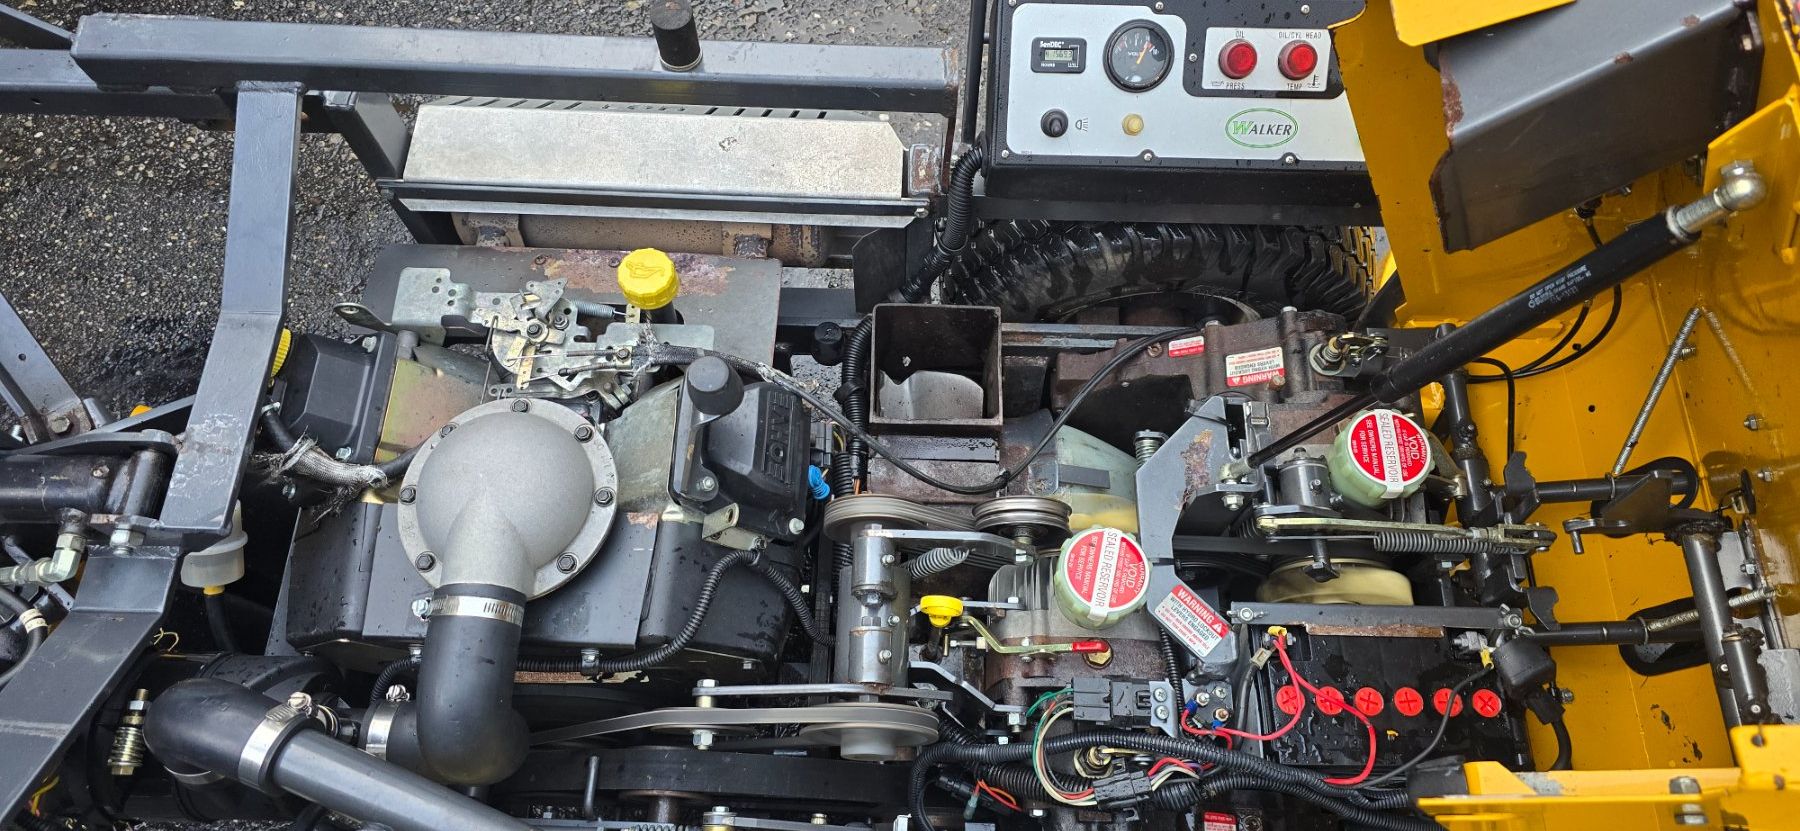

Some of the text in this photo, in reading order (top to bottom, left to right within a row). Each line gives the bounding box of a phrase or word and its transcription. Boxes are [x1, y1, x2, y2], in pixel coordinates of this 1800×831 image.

[1232, 120, 1292, 135] WALKER
[1361, 441, 1370, 463] SERVICE
[1368, 429, 1377, 452] OWNERS
[1379, 413, 1399, 483] SEALED RESERVOIR
[1408, 436, 1420, 460] VOID
[1417, 433, 1427, 464] WARRANTY
[1075, 557, 1084, 581] SERVICE
[1095, 532, 1117, 607] SEALED RESERVOIR
[1127, 563, 1138, 588] VOID
[1170, 597, 1182, 608] WITH
[1181, 607, 1198, 622] HYDRO
[1198, 621, 1219, 641] LOCKOUT
[1177, 588, 1215, 624] WARNING
[1171, 605, 1188, 621] LEVERS
[1188, 621, 1210, 640] ENGAGED
